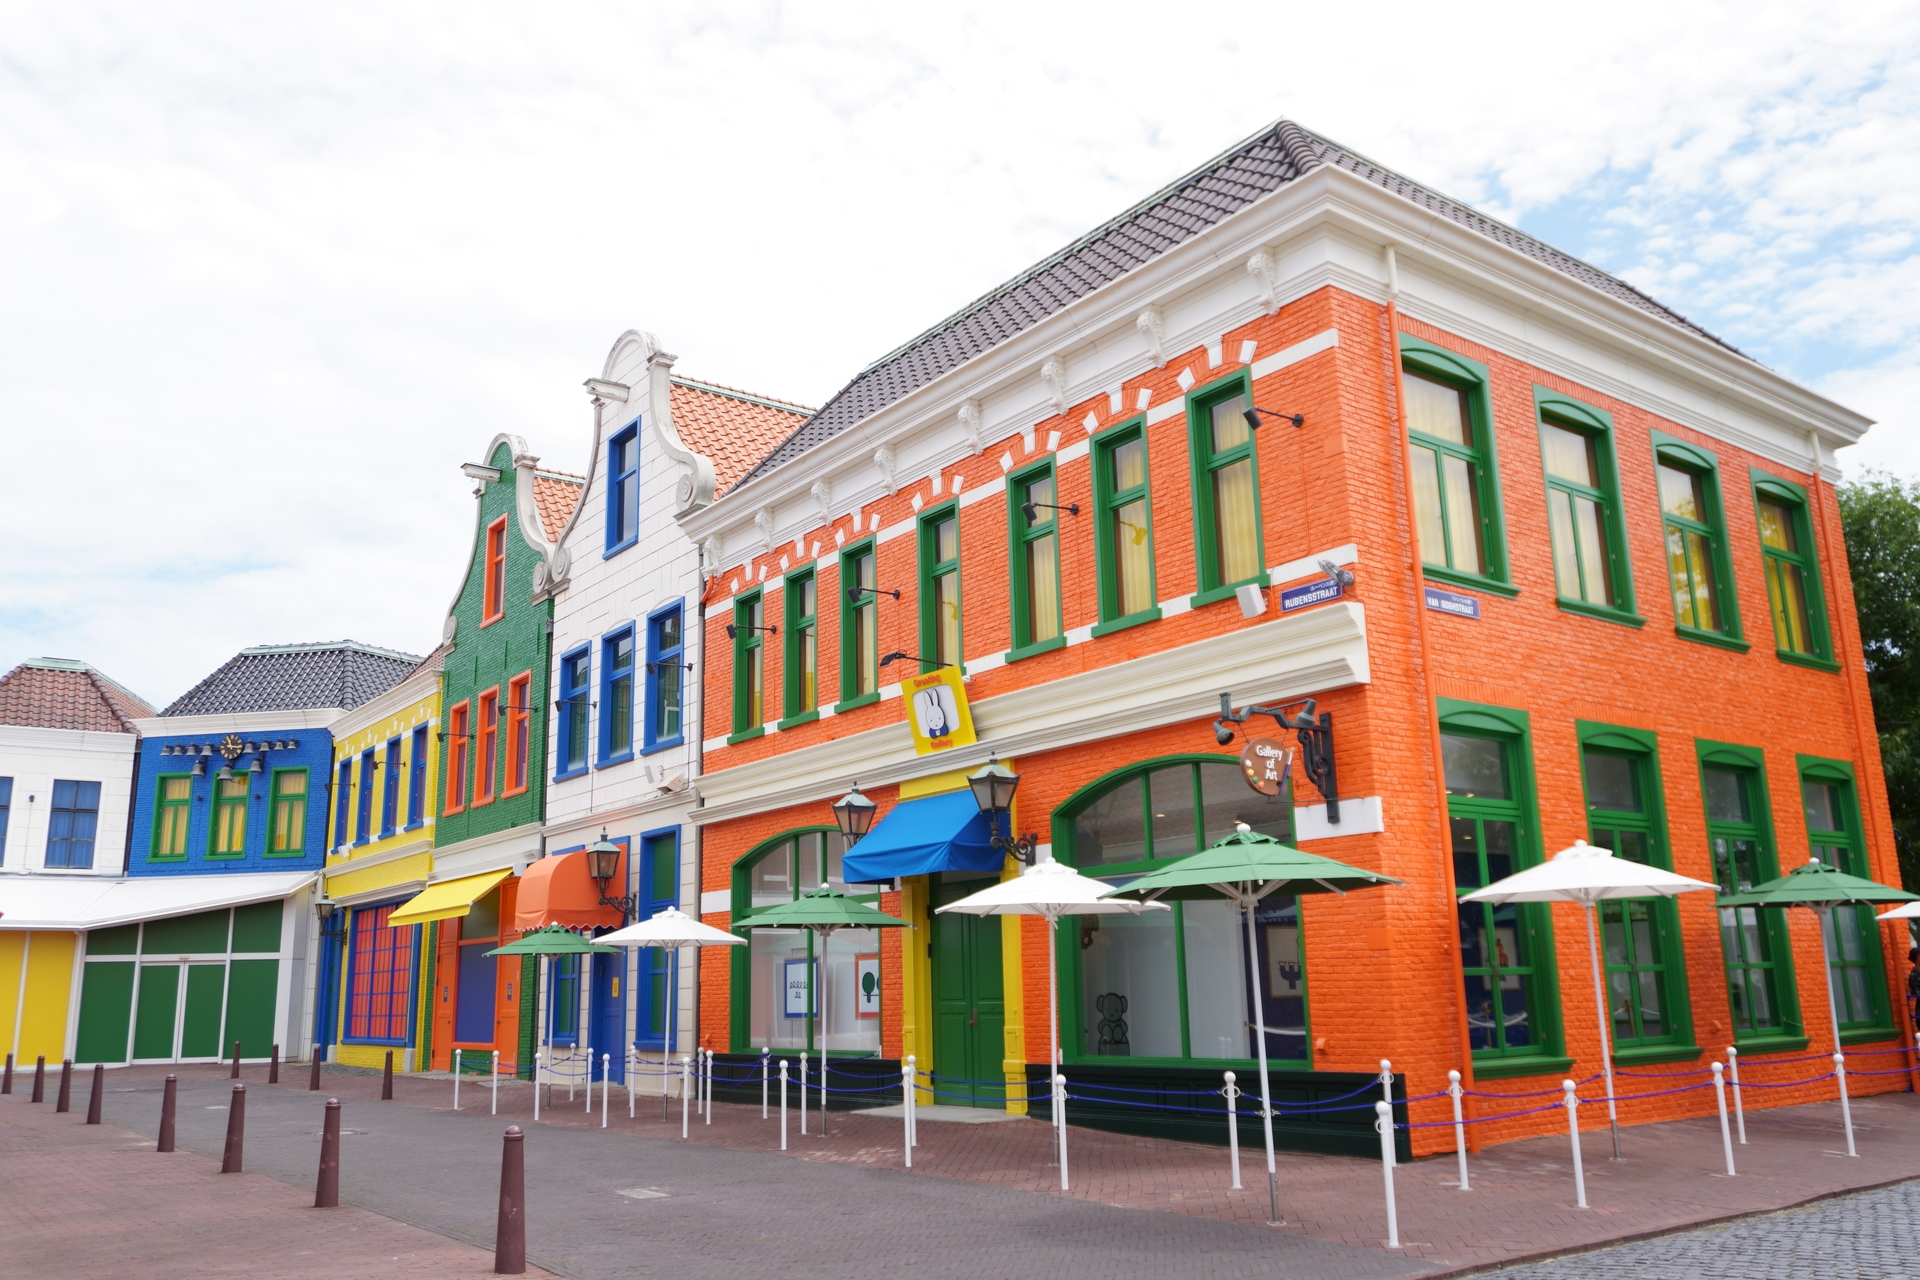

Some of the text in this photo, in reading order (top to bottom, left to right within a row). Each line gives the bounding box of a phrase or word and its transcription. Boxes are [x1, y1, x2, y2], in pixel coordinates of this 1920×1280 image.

[1285, 587, 1338, 608] RUBENSSTRAAT
[1427, 597, 1439, 607] VAN
[931, 739, 953, 749] Gallery
[1256, 745, 1282, 761] Gallery
[1266, 759, 1275, 769] of
[1265, 769, 1278, 780] Art
